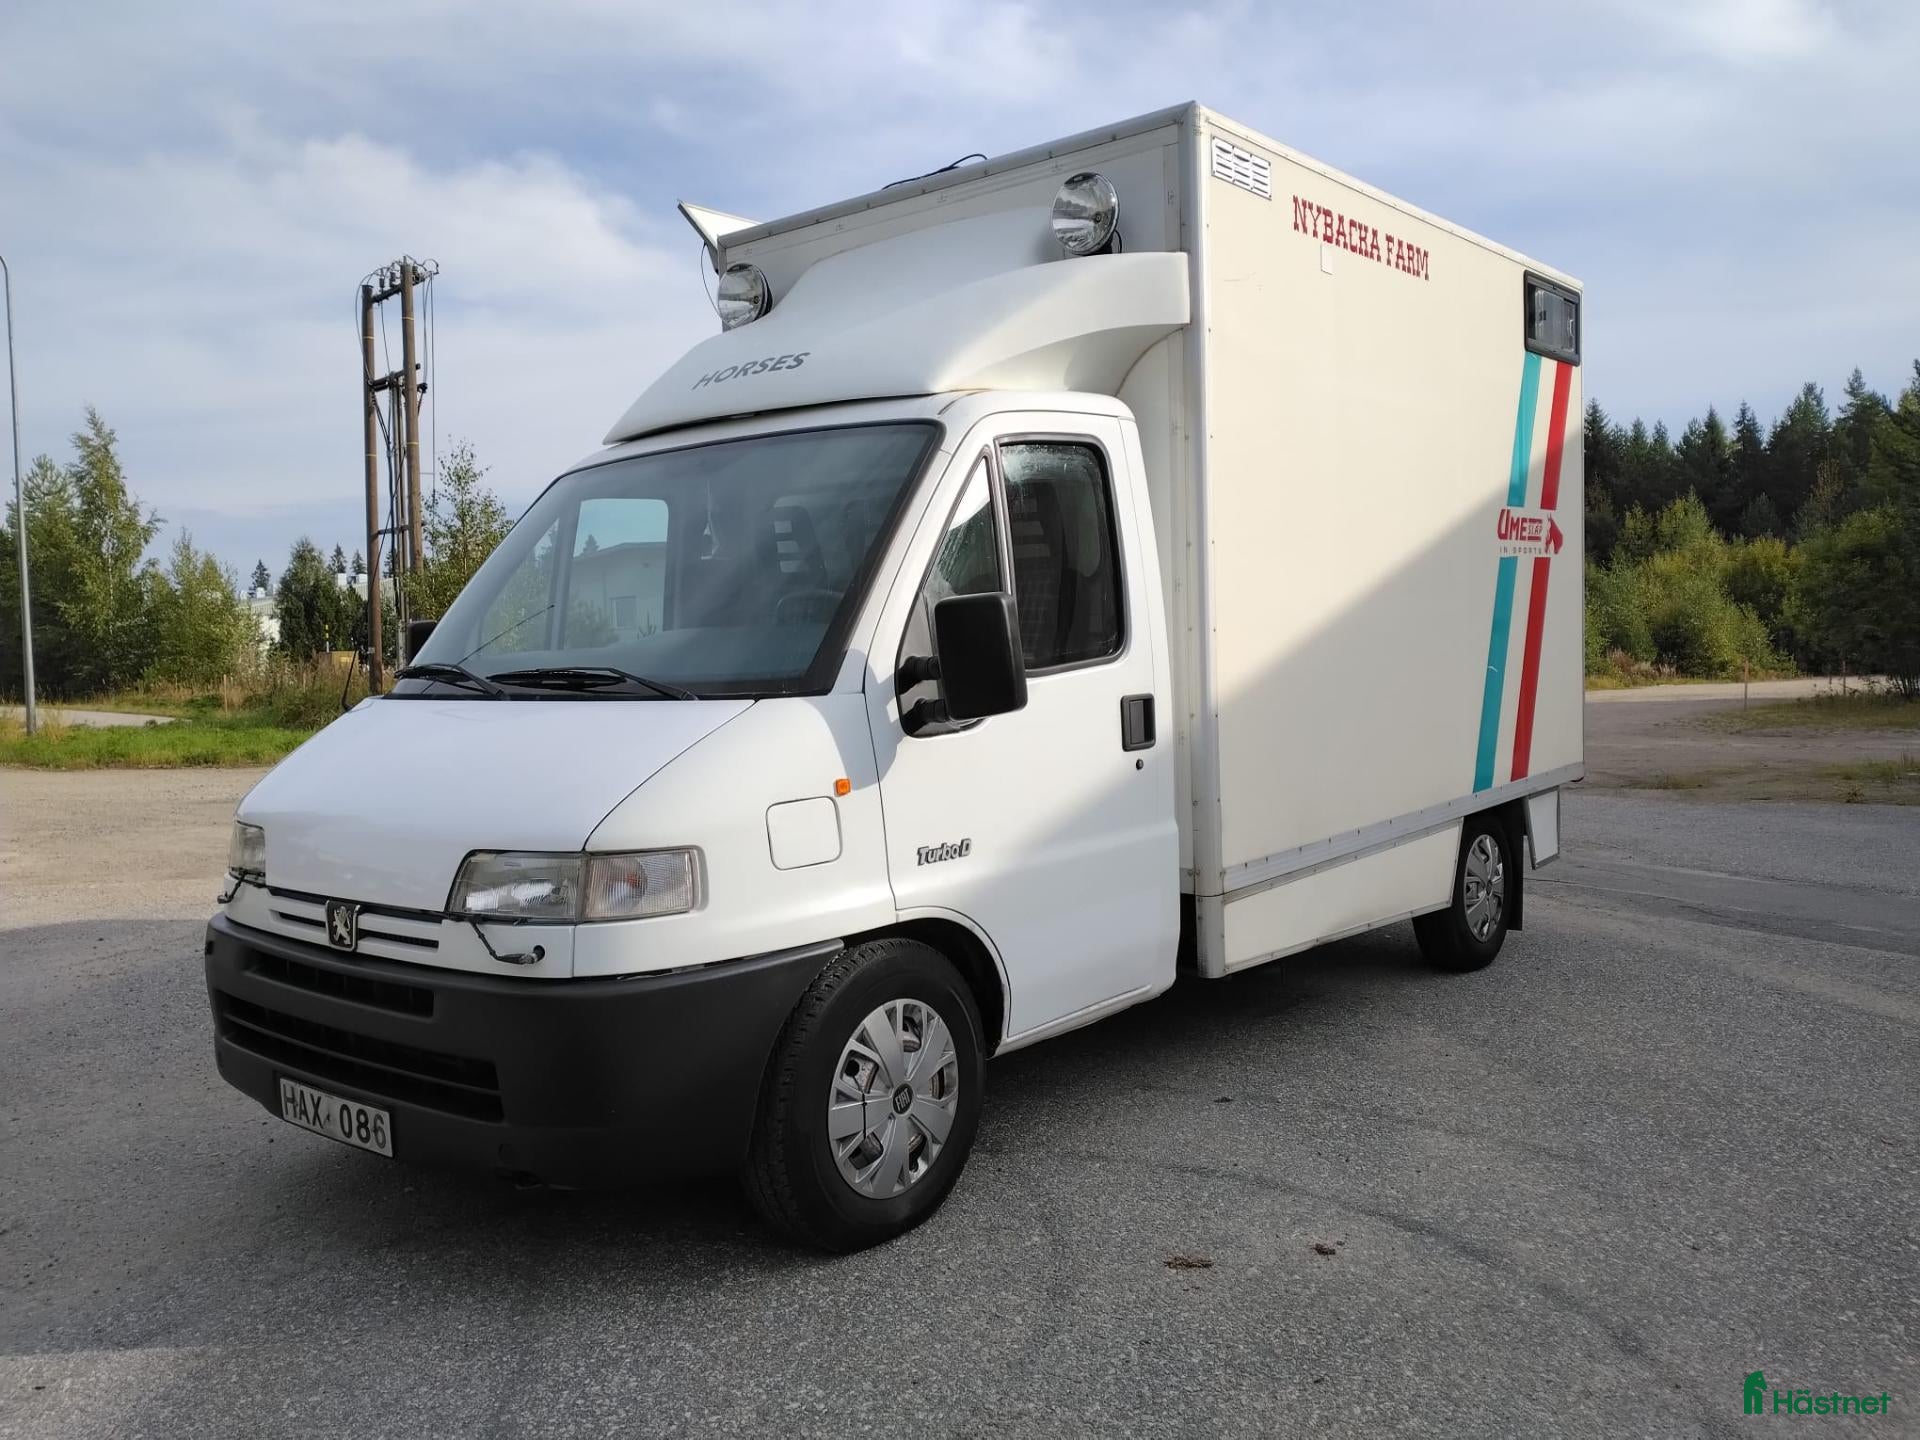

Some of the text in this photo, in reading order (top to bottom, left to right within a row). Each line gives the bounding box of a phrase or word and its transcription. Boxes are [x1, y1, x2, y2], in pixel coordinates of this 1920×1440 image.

[1292, 194, 1429, 281] NYBACKA FARM
[691, 352, 811, 390] HORSES
[282, 1083, 387, 1149] HAX 086
[895, 1087, 911, 1112] FIAT
